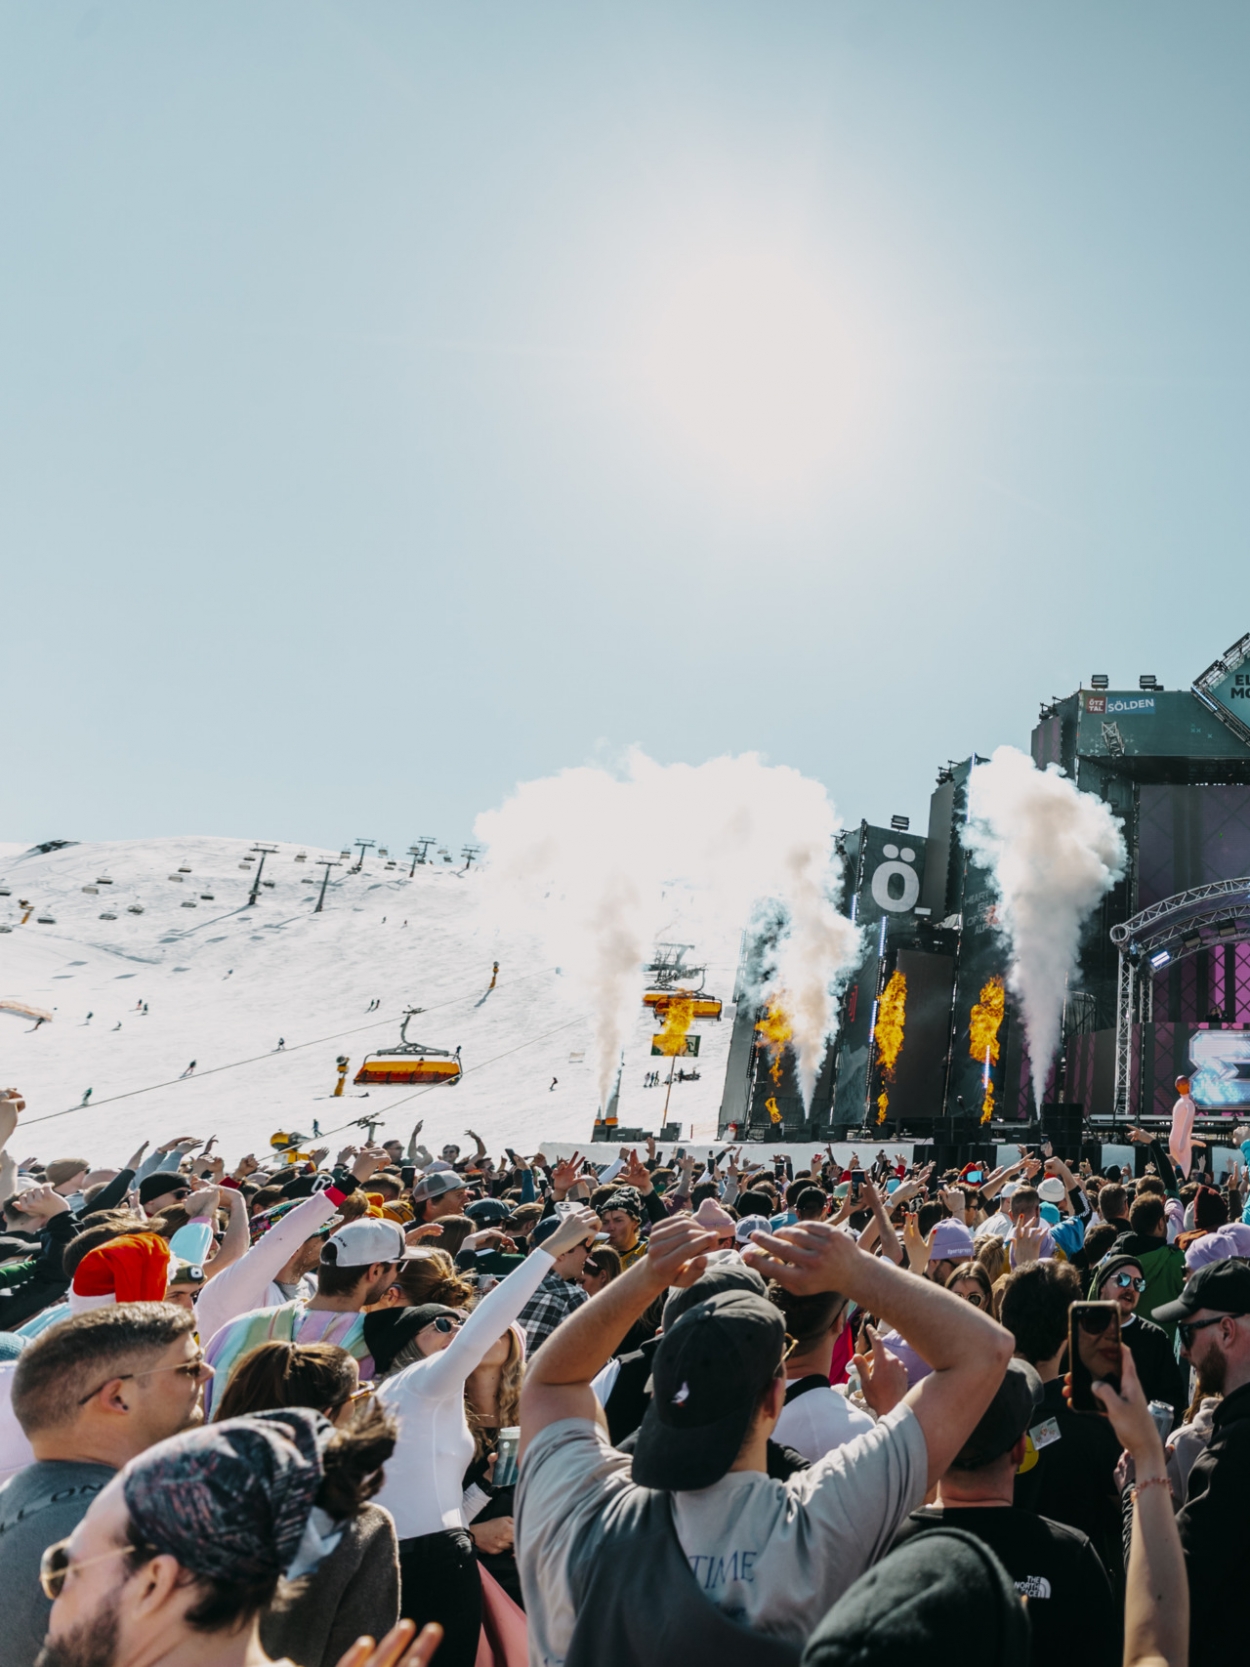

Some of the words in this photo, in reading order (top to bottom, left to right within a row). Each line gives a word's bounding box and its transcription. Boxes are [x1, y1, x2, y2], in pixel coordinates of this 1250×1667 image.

[1108, 699, 1155, 712] SÖLDEN
[688, 1551, 757, 1589] TIME
[1027, 1575, 1041, 1584] THE
